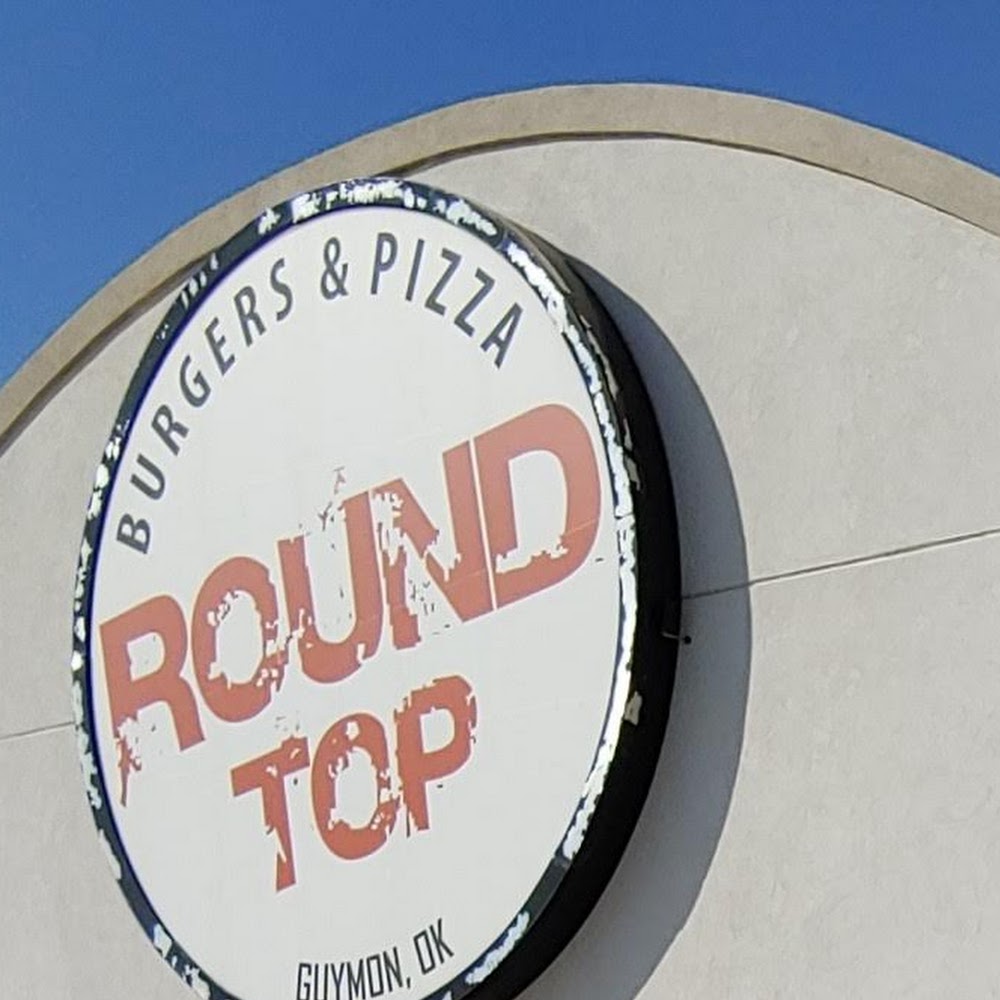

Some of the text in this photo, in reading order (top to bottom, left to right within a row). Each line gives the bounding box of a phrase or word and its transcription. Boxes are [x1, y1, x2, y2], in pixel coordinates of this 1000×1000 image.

[117, 231, 525, 555] BURGERS & PIZZA
[98, 403, 602, 807] ROUND
[230, 675, 478, 892] TOP
[416, 919, 455, 976] OK
